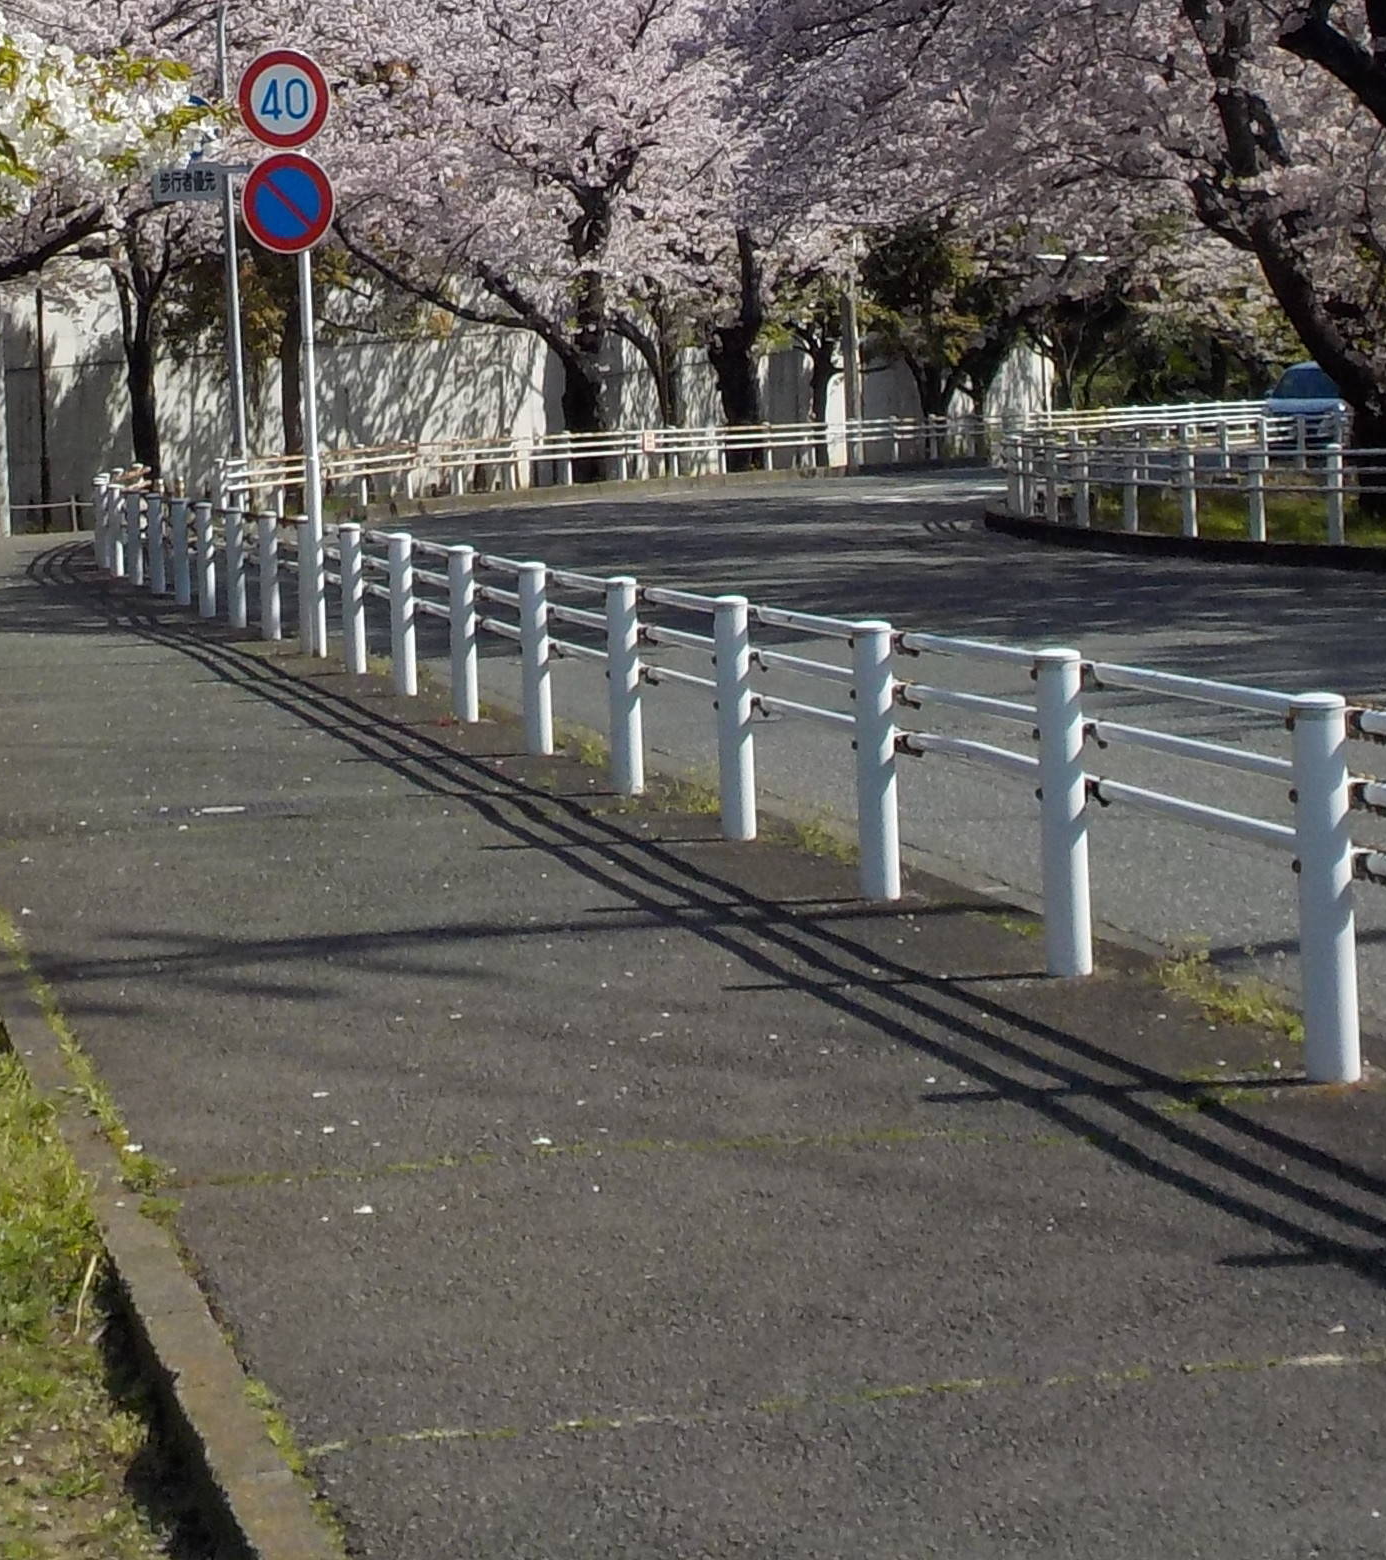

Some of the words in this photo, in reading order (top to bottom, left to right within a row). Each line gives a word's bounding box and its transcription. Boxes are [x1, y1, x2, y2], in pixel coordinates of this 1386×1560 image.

[261, 78, 308, 120] 40
[159, 169, 217, 194] 歩行者優先
